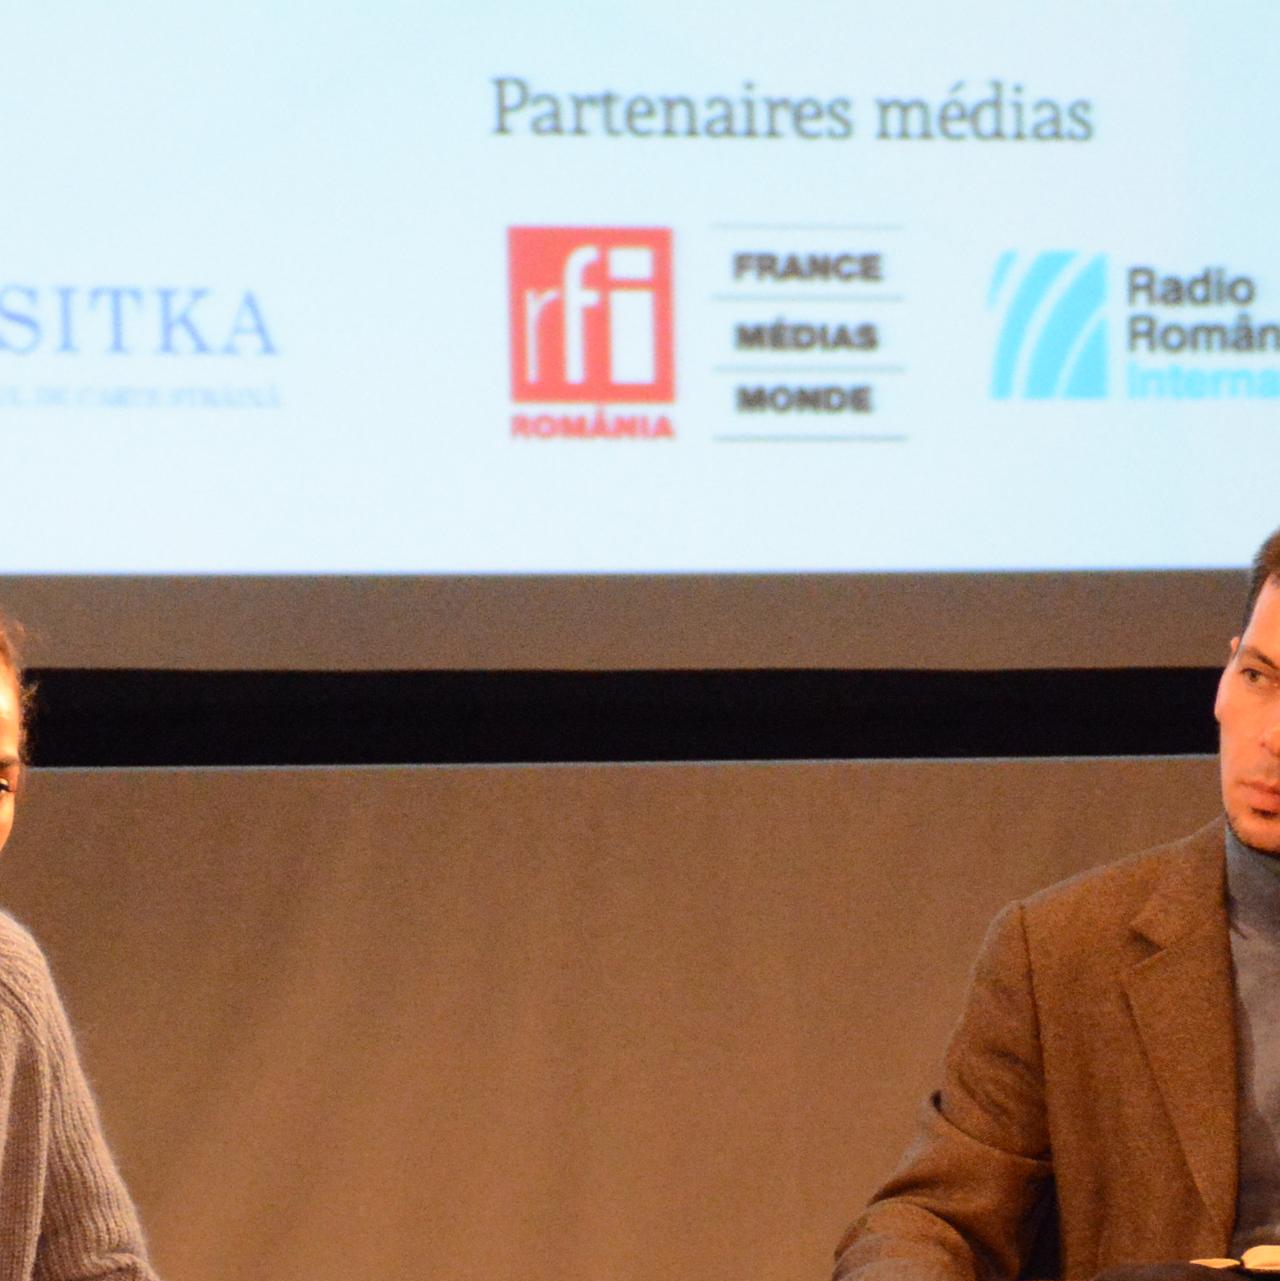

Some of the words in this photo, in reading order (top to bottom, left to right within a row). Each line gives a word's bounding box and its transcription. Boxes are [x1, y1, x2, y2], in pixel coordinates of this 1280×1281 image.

[491, 77, 854, 140] Partenaires
[875, 80, 1096, 143] médias
[733, 253, 885, 284] FRANCE
[1128, 267, 1257, 307] Radio
[524, 244, 657, 386] rfi
[735, 320, 881, 353] MÉDIAS
[736, 386, 874, 416] MONDE
[511, 404, 677, 441] ROMÂNIA
